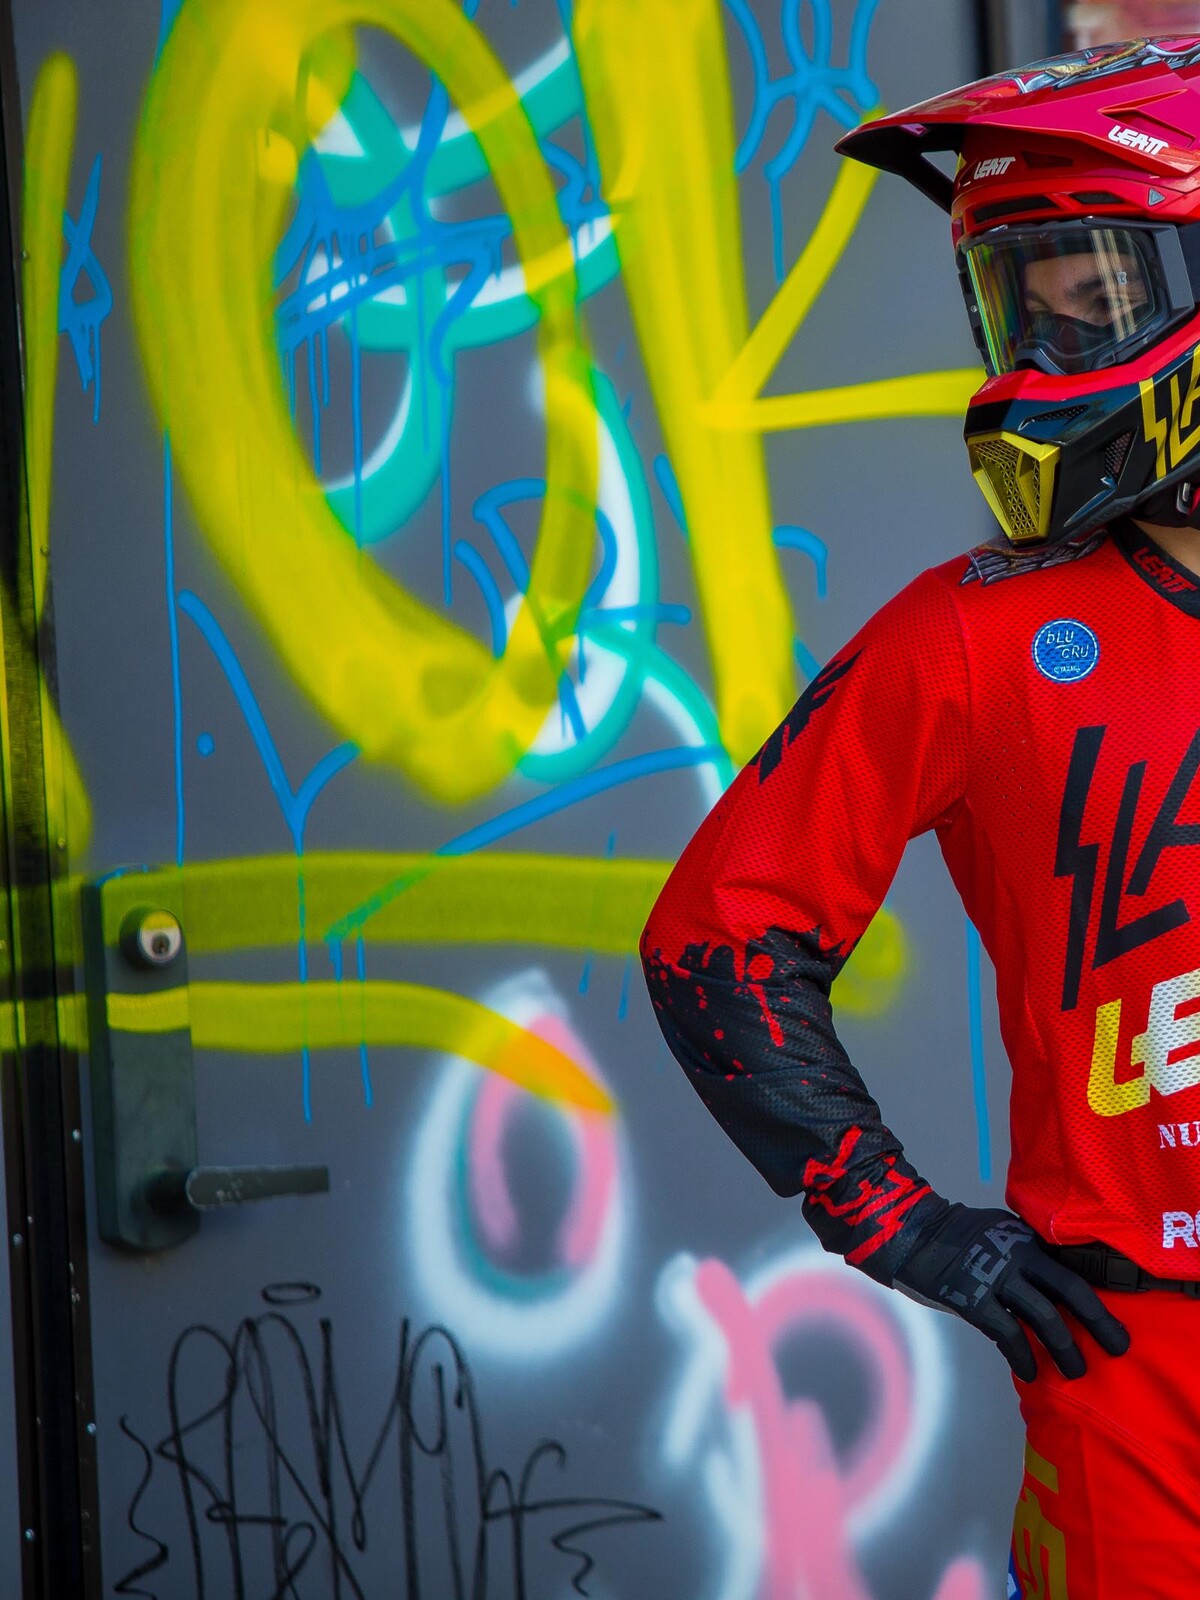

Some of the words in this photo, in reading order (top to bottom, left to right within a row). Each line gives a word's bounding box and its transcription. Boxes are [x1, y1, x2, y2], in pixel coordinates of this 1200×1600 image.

[1107, 125, 1169, 155] LEATT
[974, 156, 1016, 180] LEATT
[1132, 546, 1198, 593] LEATT
[1061, 644, 1089, 659] CRU
